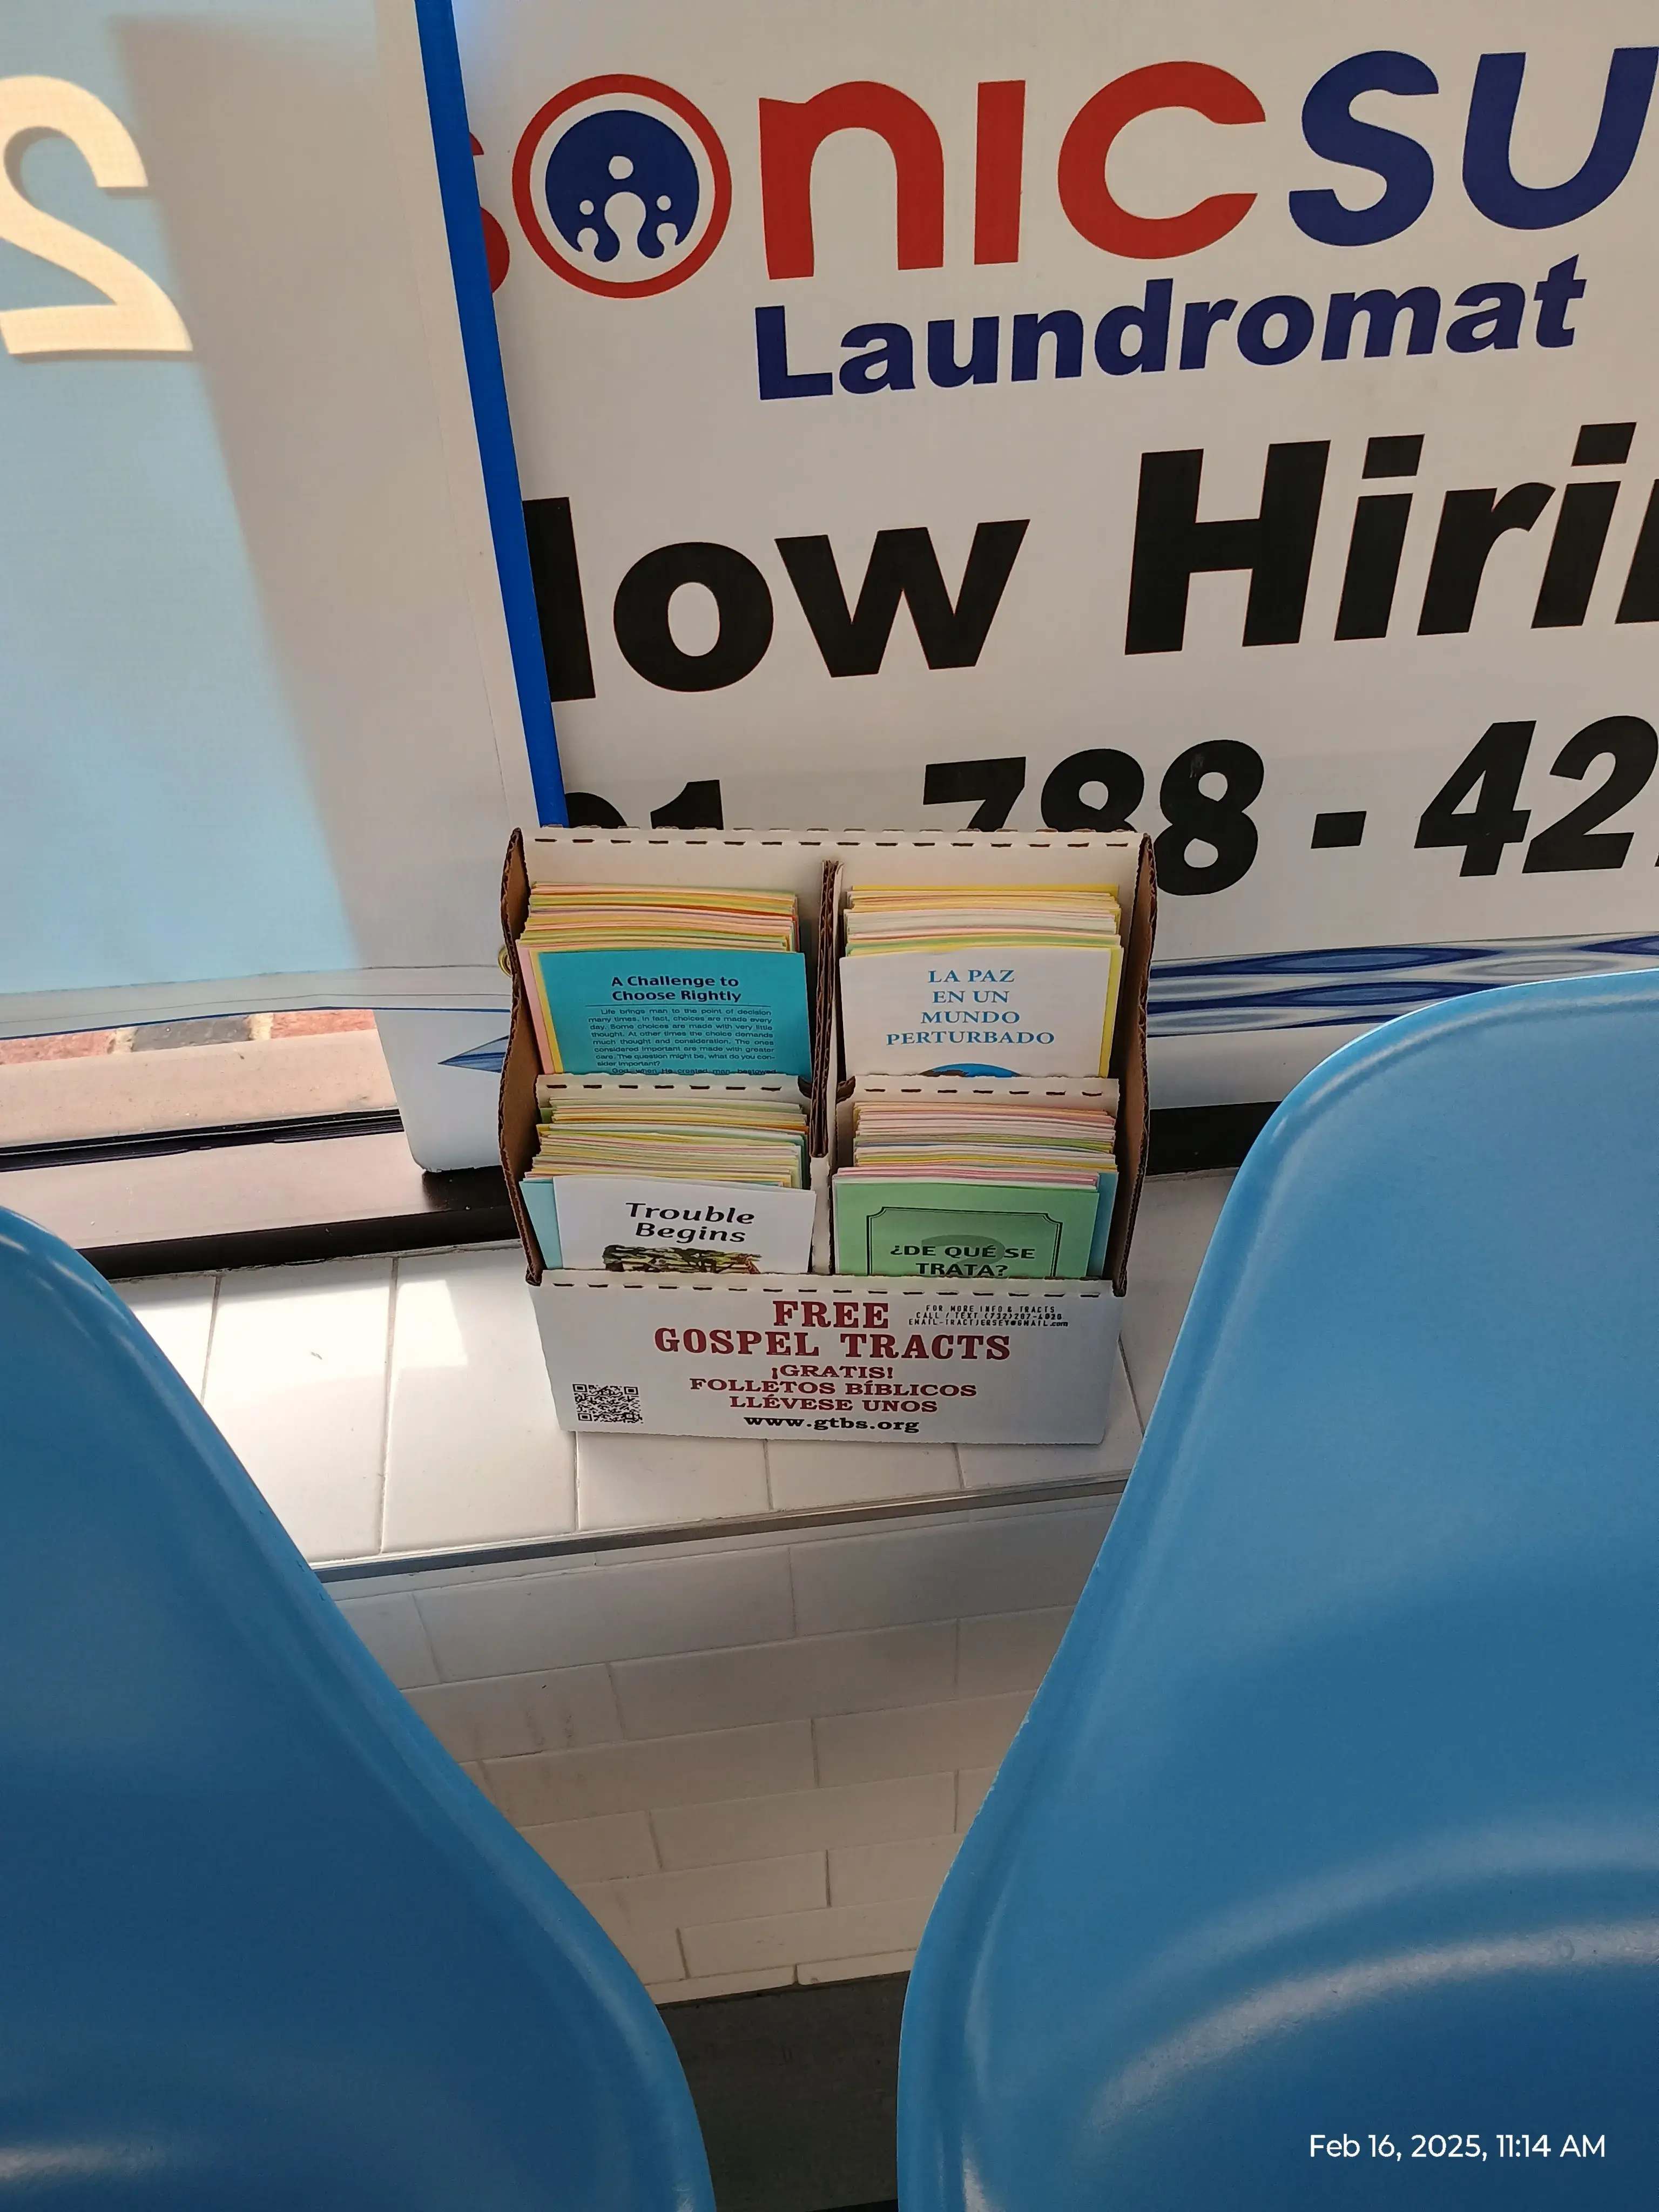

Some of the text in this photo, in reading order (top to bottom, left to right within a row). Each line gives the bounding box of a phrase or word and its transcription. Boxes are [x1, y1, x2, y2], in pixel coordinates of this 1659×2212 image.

[754, 254, 1587, 401] Laundromat
[1414, 716, 1659, 876] 42
[611, 976, 739, 988] A Challenge to
[928, 969, 1015, 983] LA PAZ
[612, 990, 741, 1003] Choose Rightly
[932, 990, 1010, 1003] EN UN
[920, 1011, 1020, 1024] MUNDO
[886, 1031, 1055, 1046] PERTURBADO
[625, 1202, 754, 1224] Trouble
[635, 1222, 746, 1244] Begins
[889, 1244, 1036, 1260] ¿DE QUÉ SE
[915, 1263, 1008, 1277] TRATA?
[772, 1300, 889, 1329] FREE
[926, 1304, 943, 1312] FOR
[950, 1305, 975, 1313] MORE
[980, 1305, 1003, 1313] INFO
[654, 1327, 1010, 1360] GOSPEL TRACTS
[772, 1365, 893, 1379] ¡GRATIS!
[689, 1378, 977, 1397] FOLLETOS BÍBLICOS
[729, 1394, 938, 1412] LLÉVESE UNOS
[744, 1417, 920, 1433] www.gtbs.org
